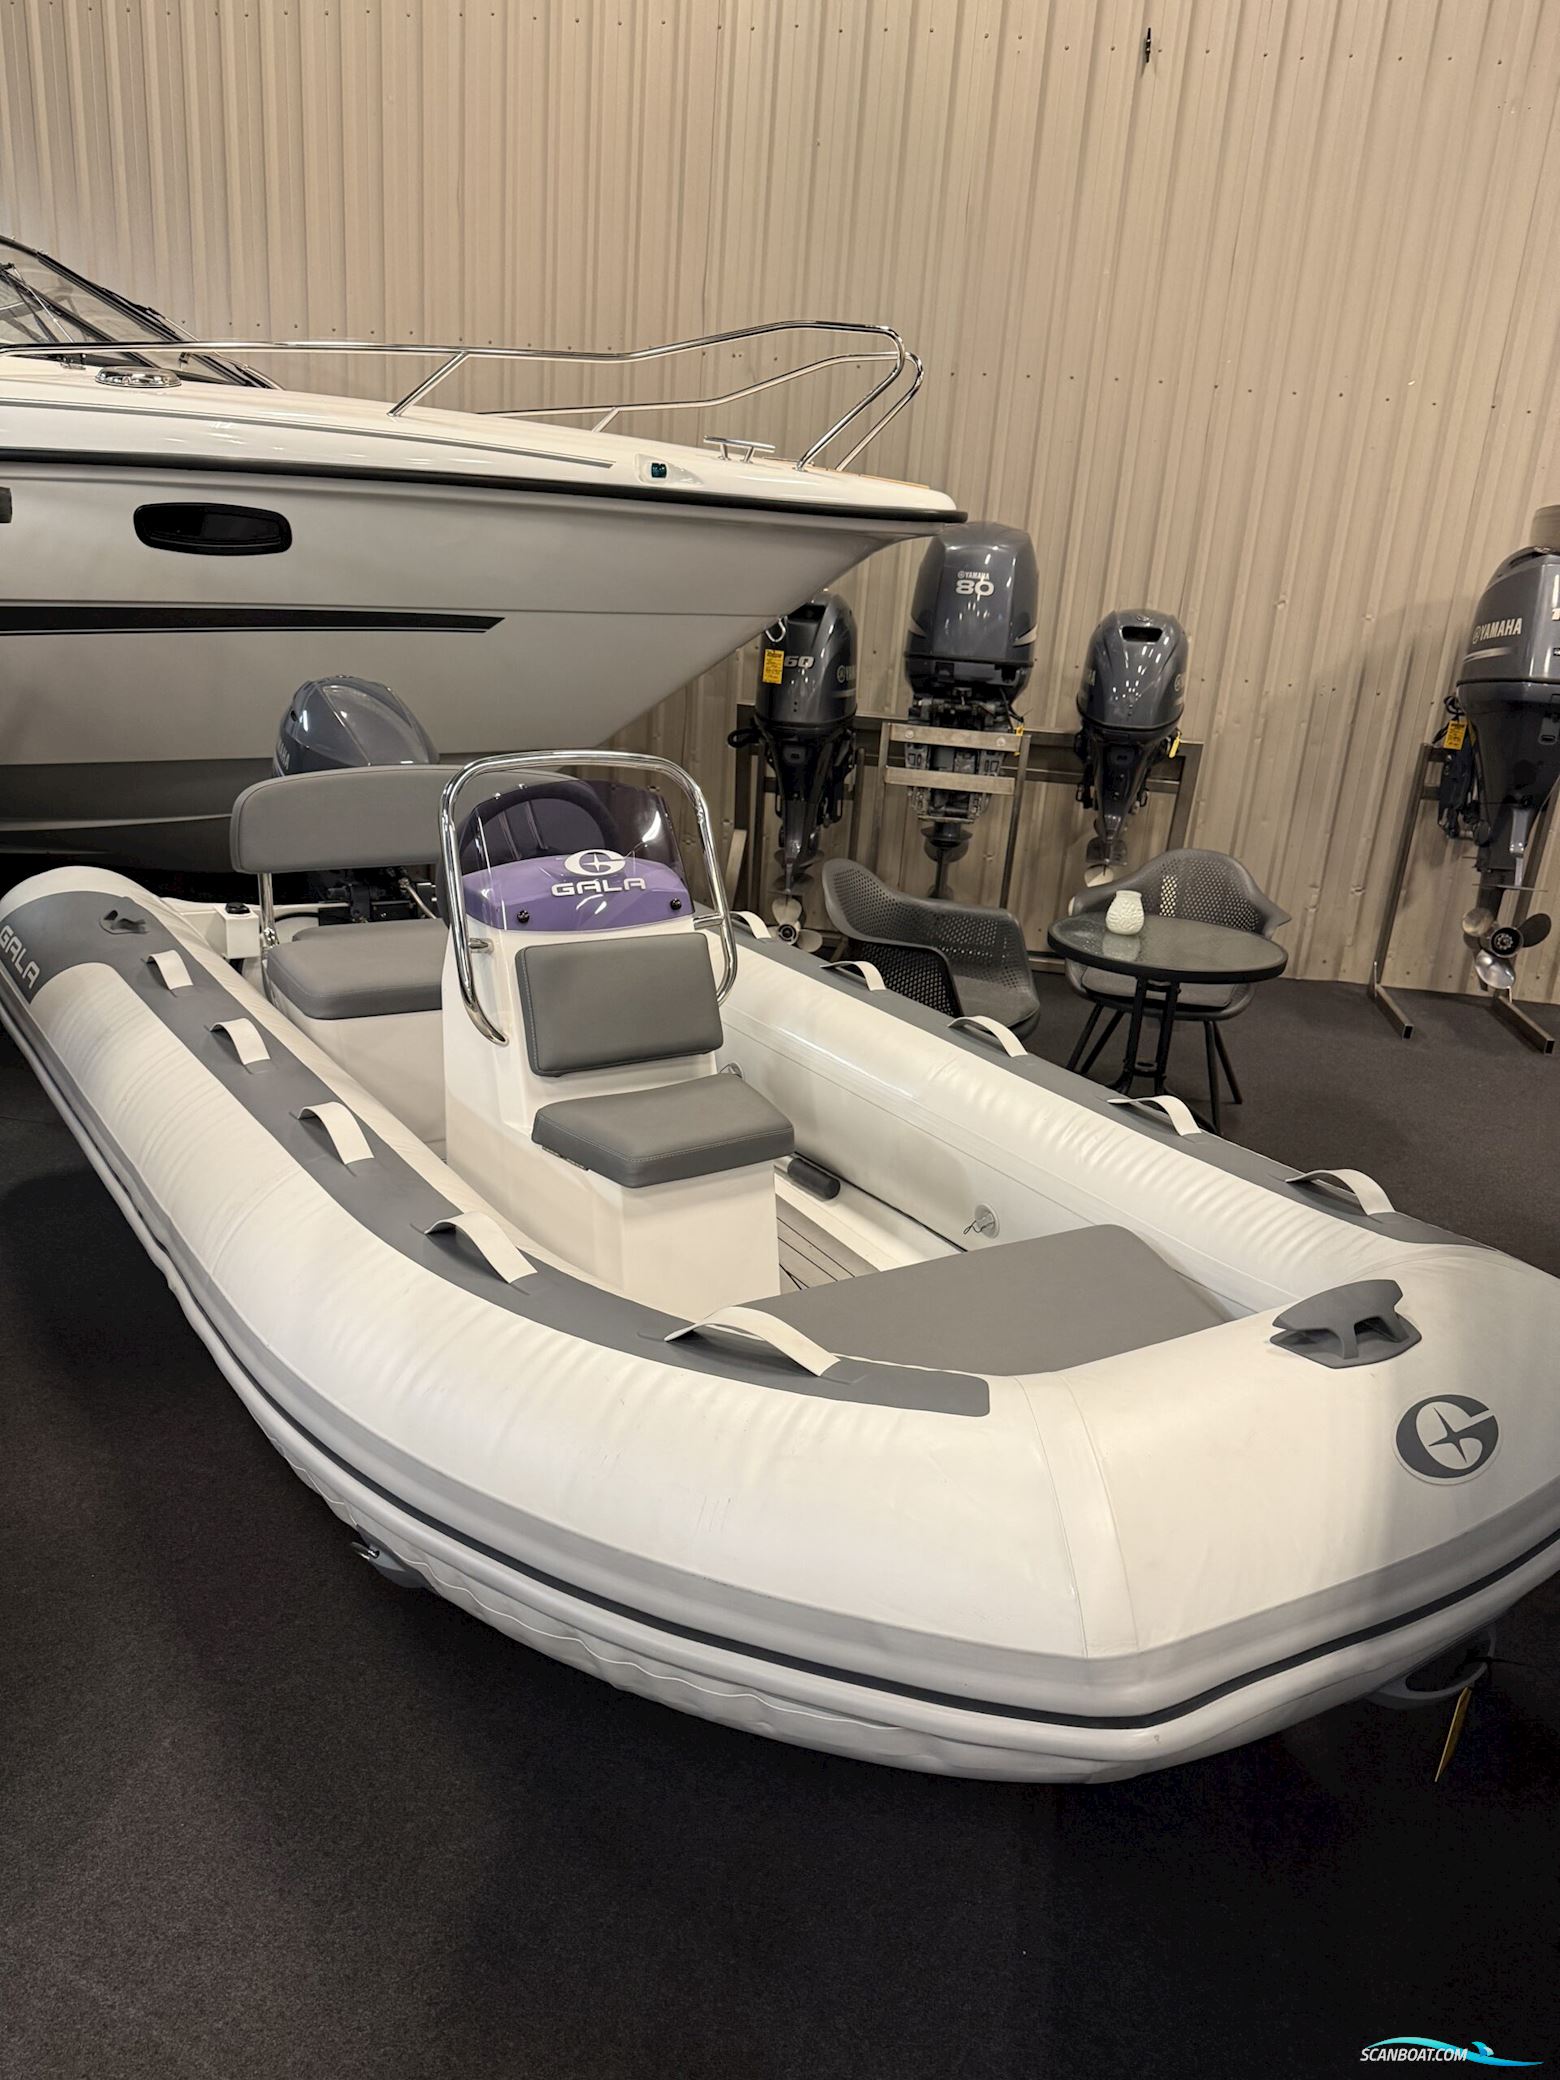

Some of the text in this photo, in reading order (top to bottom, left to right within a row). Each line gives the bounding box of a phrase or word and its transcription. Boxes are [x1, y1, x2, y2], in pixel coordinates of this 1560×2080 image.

[965, 571, 990, 580] YAMAHA
[956, 580, 994, 596] 80
[1480, 617, 1523, 641] YAMAHA
[784, 656, 815, 668] 60
[551, 877, 647, 897] GALA
[0, 925, 40, 989] GALA
